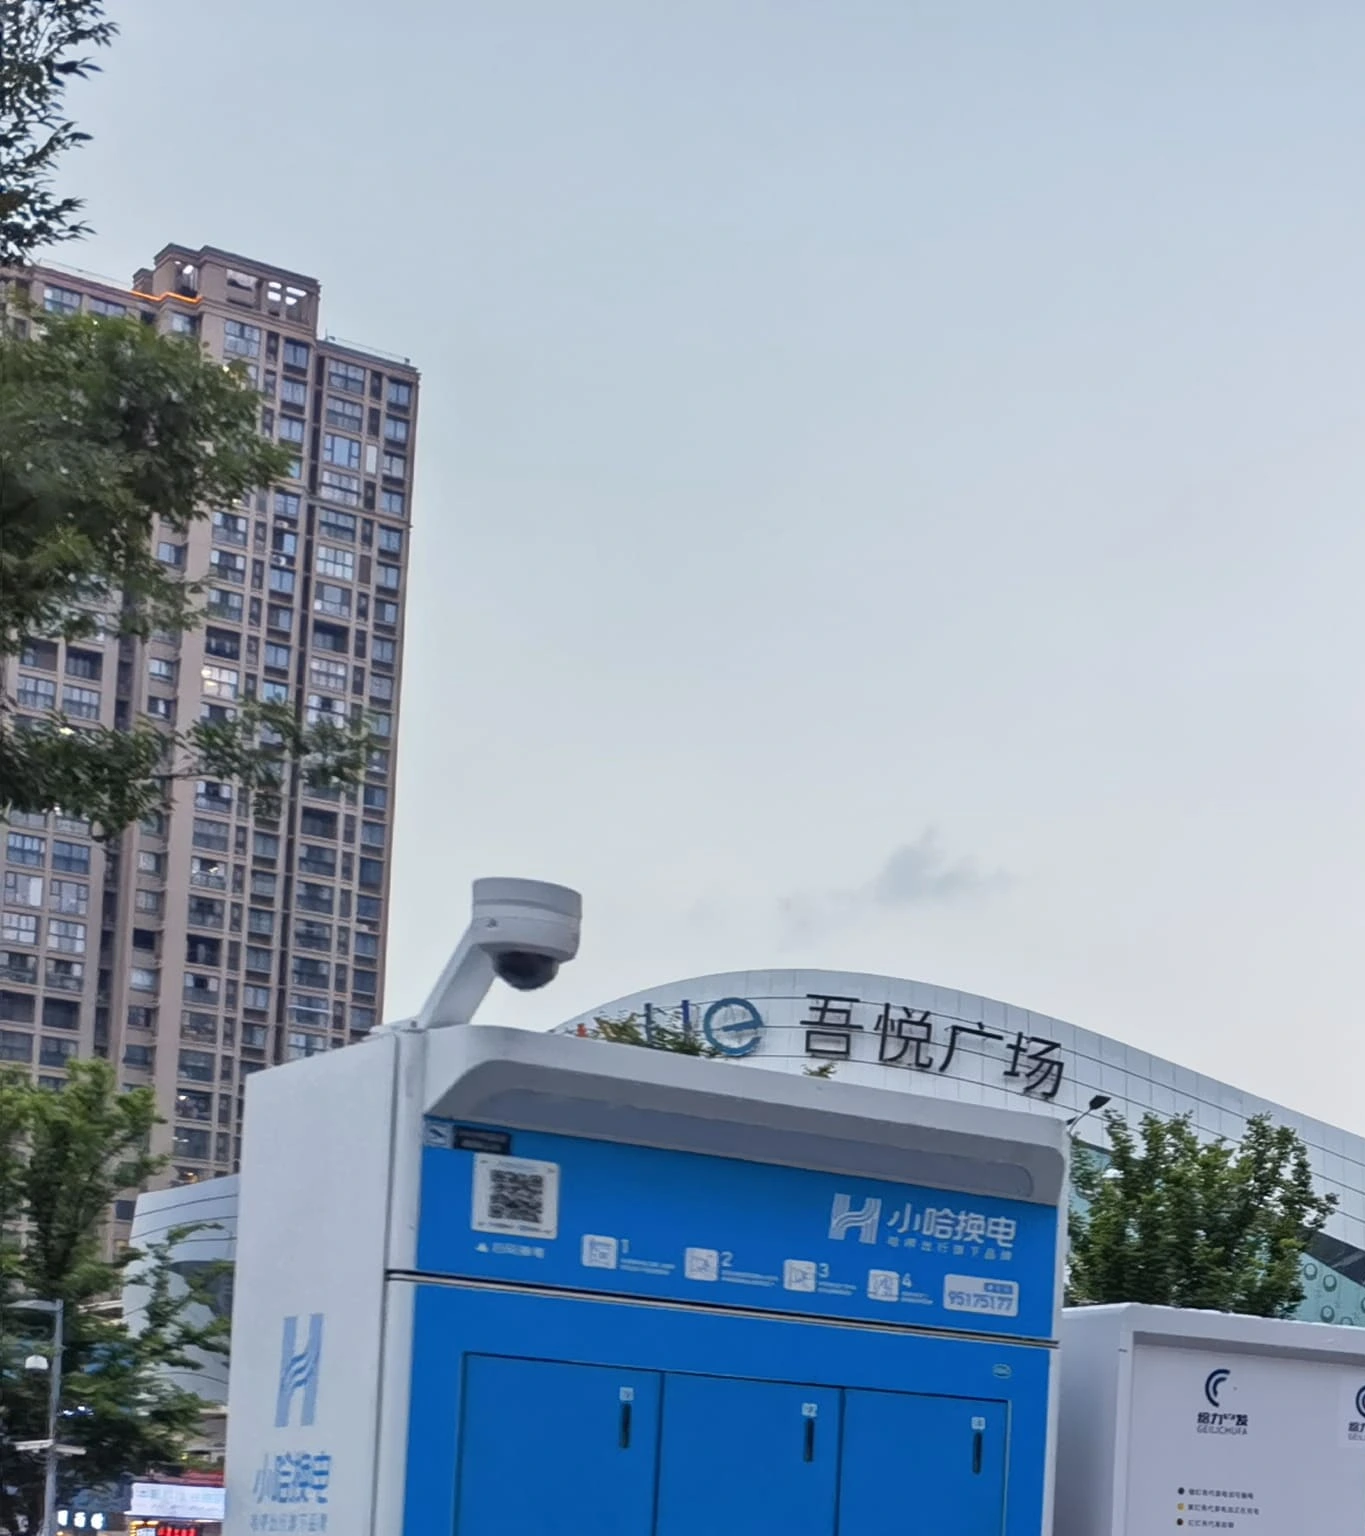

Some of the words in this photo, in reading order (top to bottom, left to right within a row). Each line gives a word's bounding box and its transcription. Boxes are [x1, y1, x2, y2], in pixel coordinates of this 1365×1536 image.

[800, 993, 1064, 1099] 吾悦广场
[887, 1203, 1017, 1248] 小哈换电
[720, 1251, 734, 1267] 2
[818, 1263, 830, 1279] 3
[902, 1273, 913, 1288] 4
